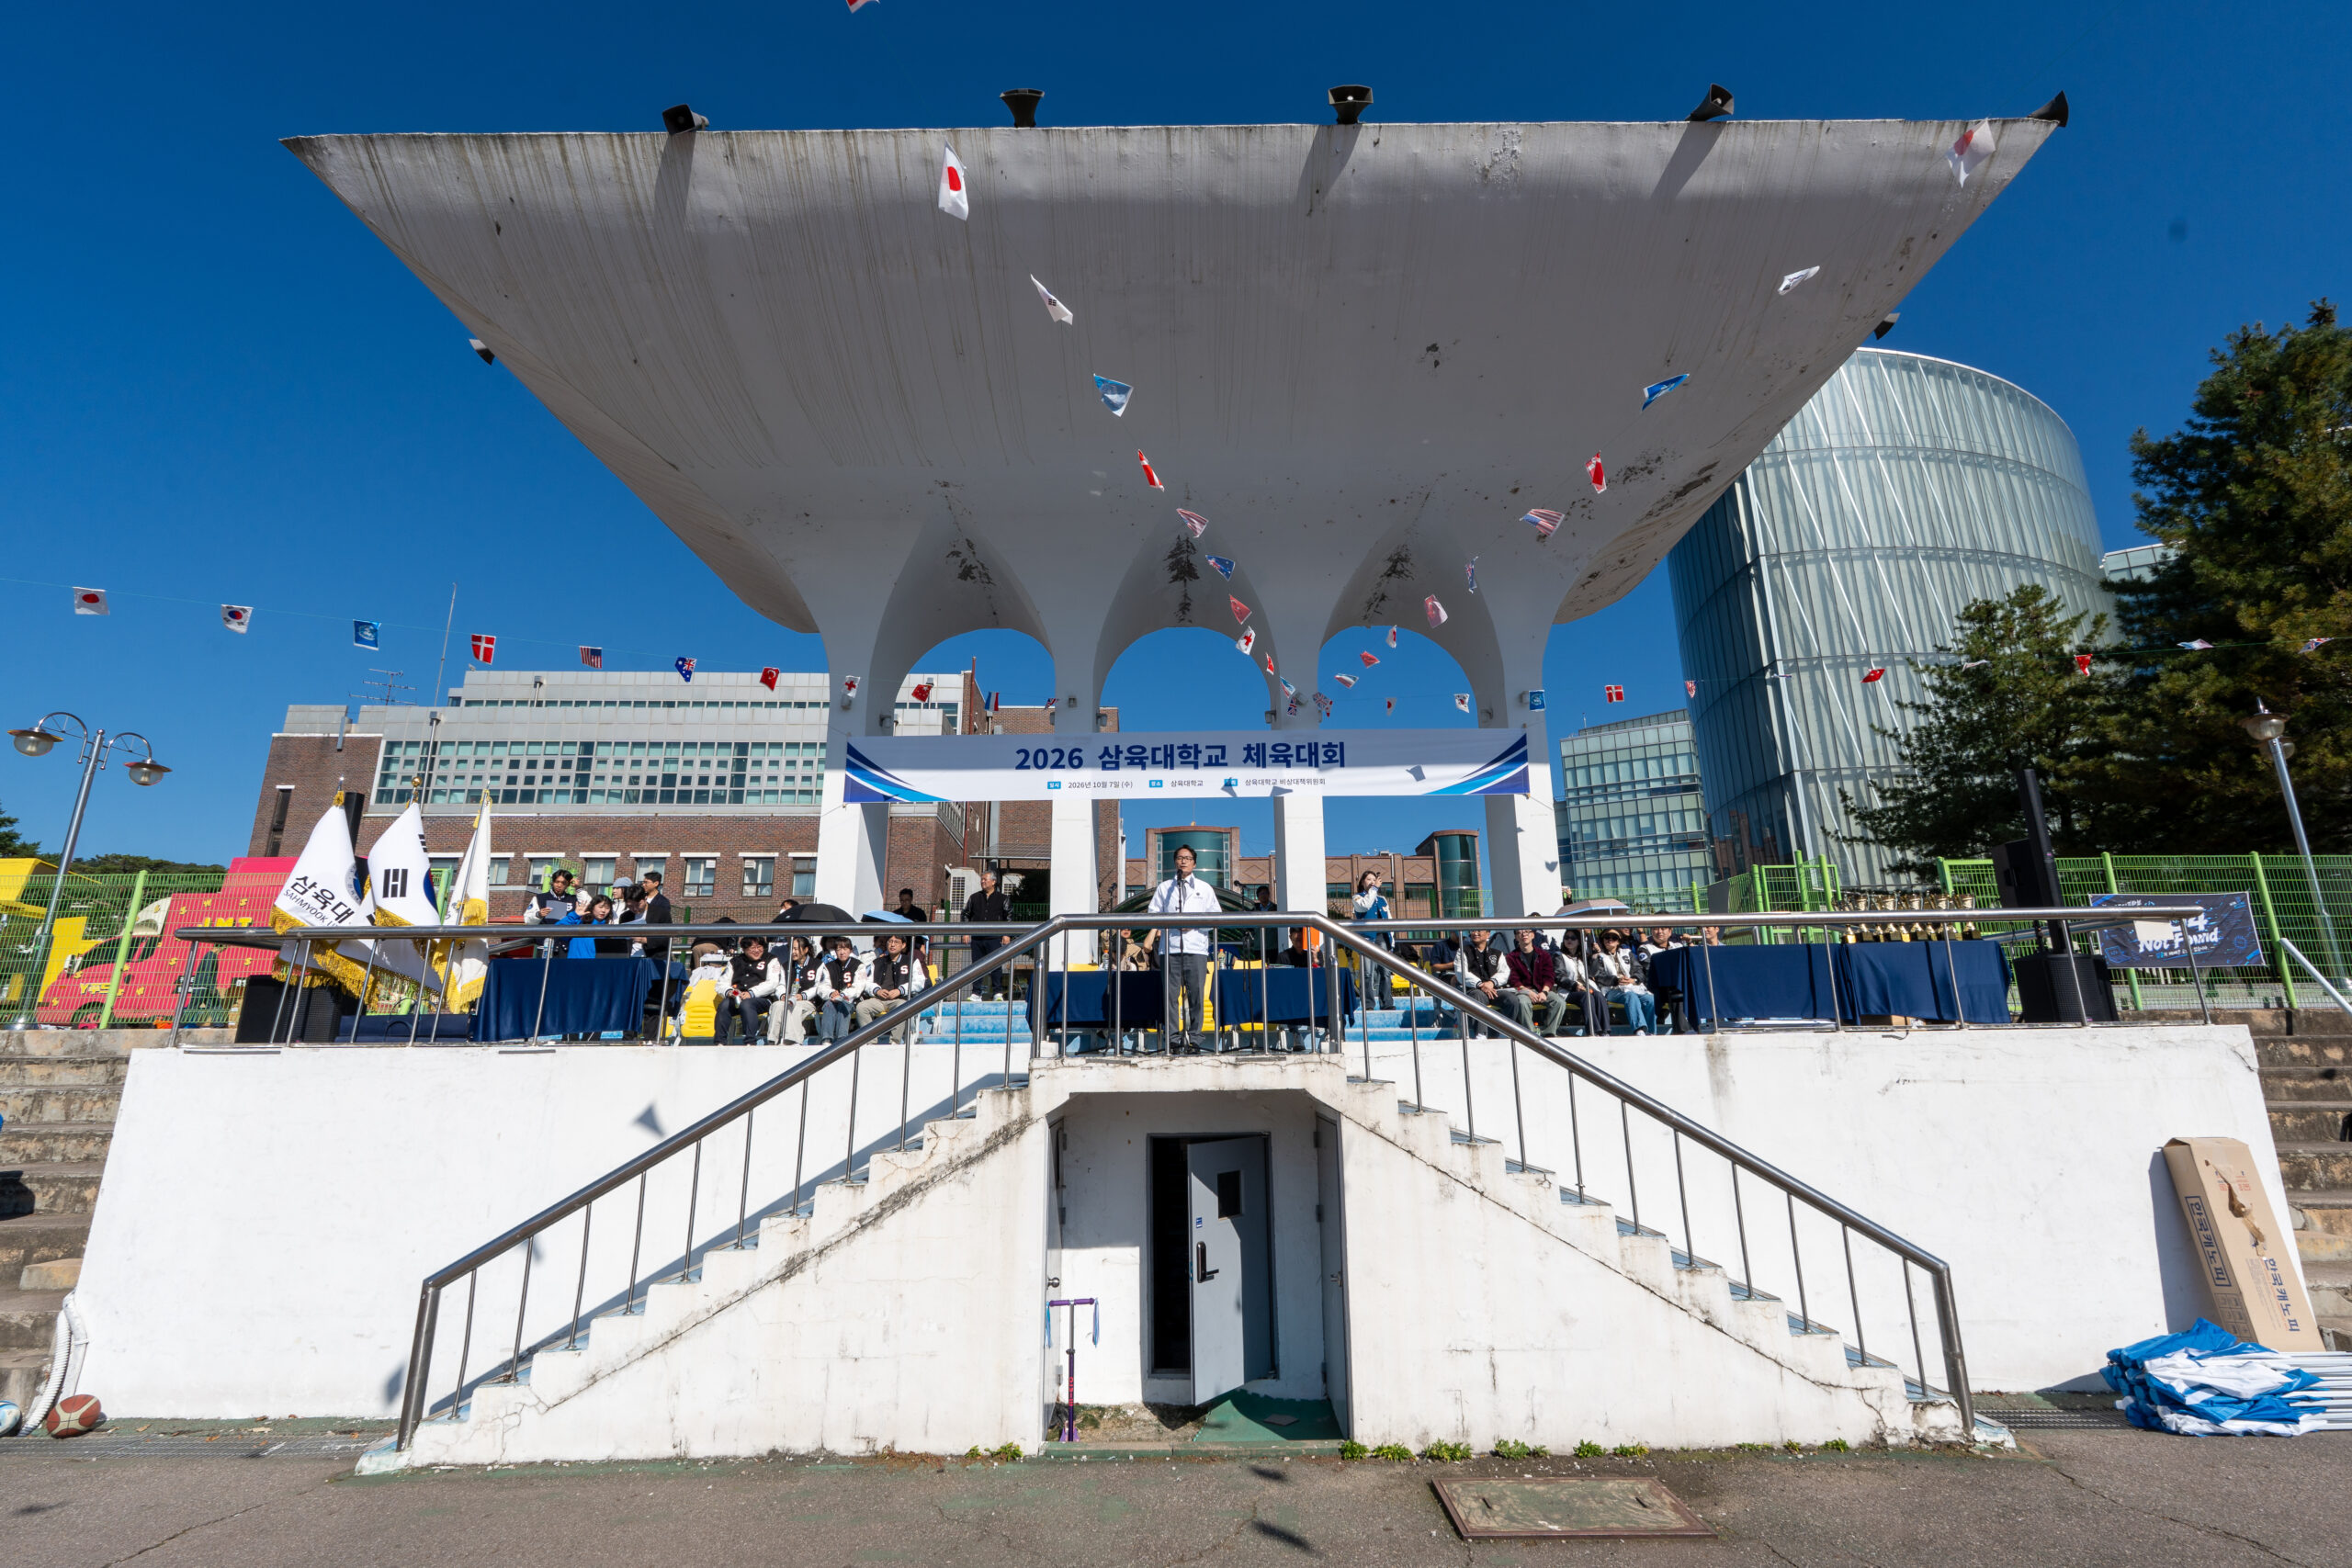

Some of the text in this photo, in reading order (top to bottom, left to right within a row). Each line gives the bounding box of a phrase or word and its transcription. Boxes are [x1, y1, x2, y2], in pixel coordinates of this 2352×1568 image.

[1014, 741, 1346, 772] 2026 삼육대학교 체육대회
[1068, 781, 1091, 789] 2026년
[1092, 781, 1108, 789] 10월
[1109, 781, 1120, 789] 7일
[1121, 780, 1134, 789] (수)
[1170, 779, 1204, 787] 삼육대학교
[1245, 778, 1278, 786] 삼육대학교
[1279, 778, 1326, 786] 비상대책위원회
[290, 875, 356, 924] 삼육대
[283, 889, 329, 924] SAHMYOOK
[2138, 939, 2170, 953] Not
[756, 961, 765, 971] S
[899, 964, 909, 975] S
[807, 969, 816, 981] S
[843, 971, 853, 983] S
[2190, 1201, 2226, 1281] 한국캐노피
[2264, 1258, 2301, 1332] 한국캐노피
